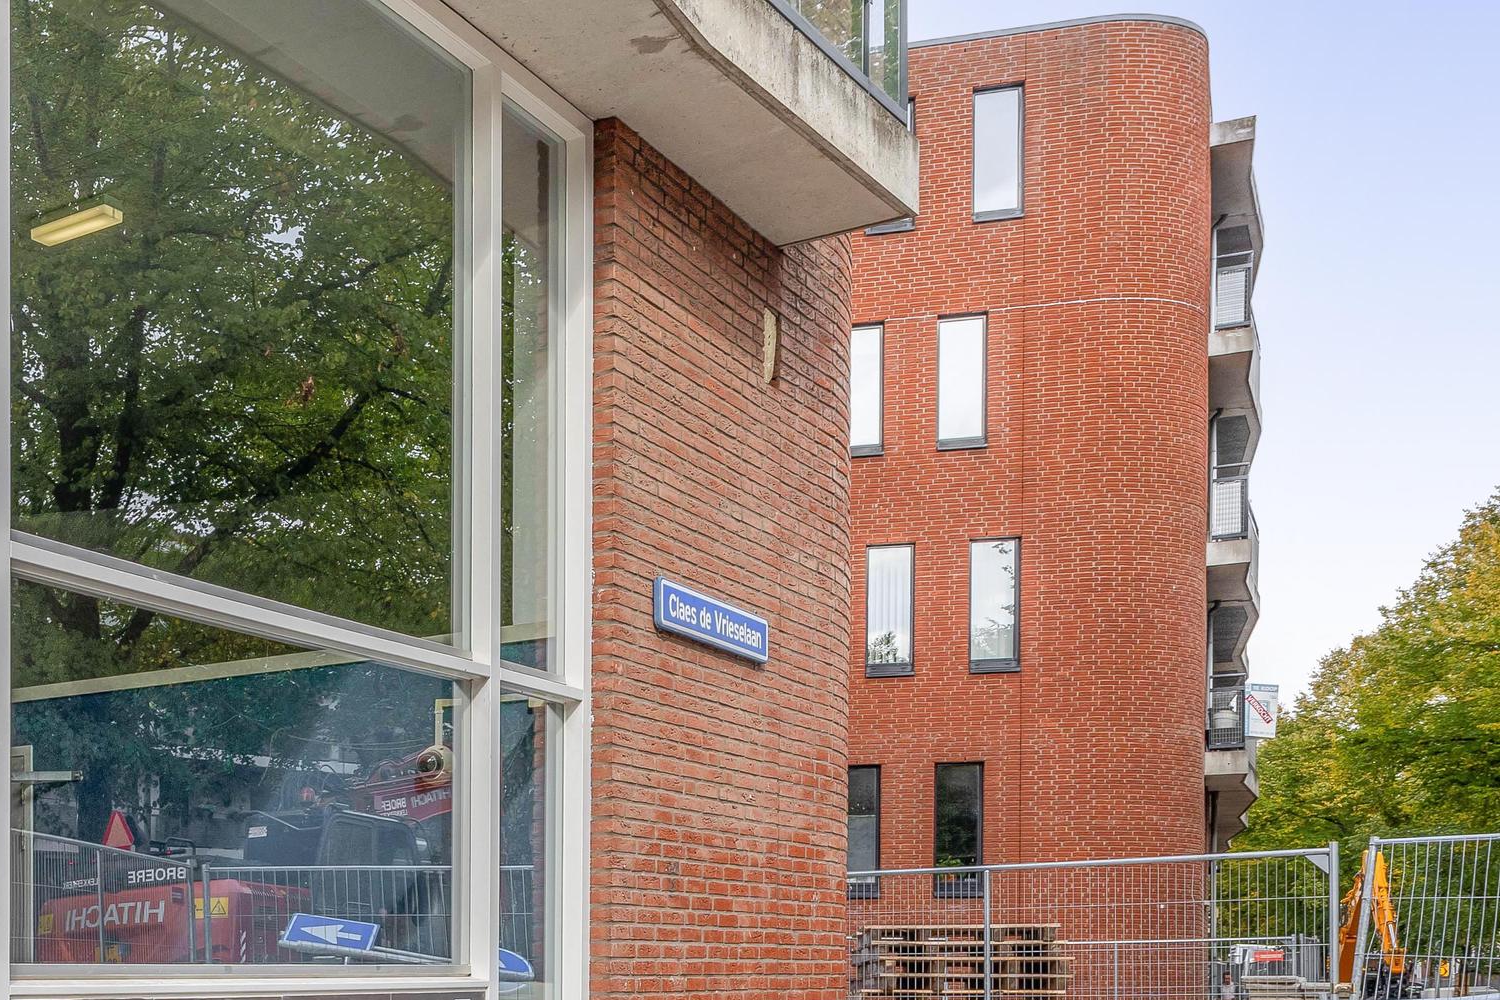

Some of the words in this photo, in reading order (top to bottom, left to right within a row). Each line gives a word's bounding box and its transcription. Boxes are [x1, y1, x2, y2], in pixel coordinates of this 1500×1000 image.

[668, 593, 697, 625] Claes
[700, 606, 712, 630] de
[714, 609, 762, 649] Vrieselaan
[1246, 695, 1273, 724] VERKOCHT
